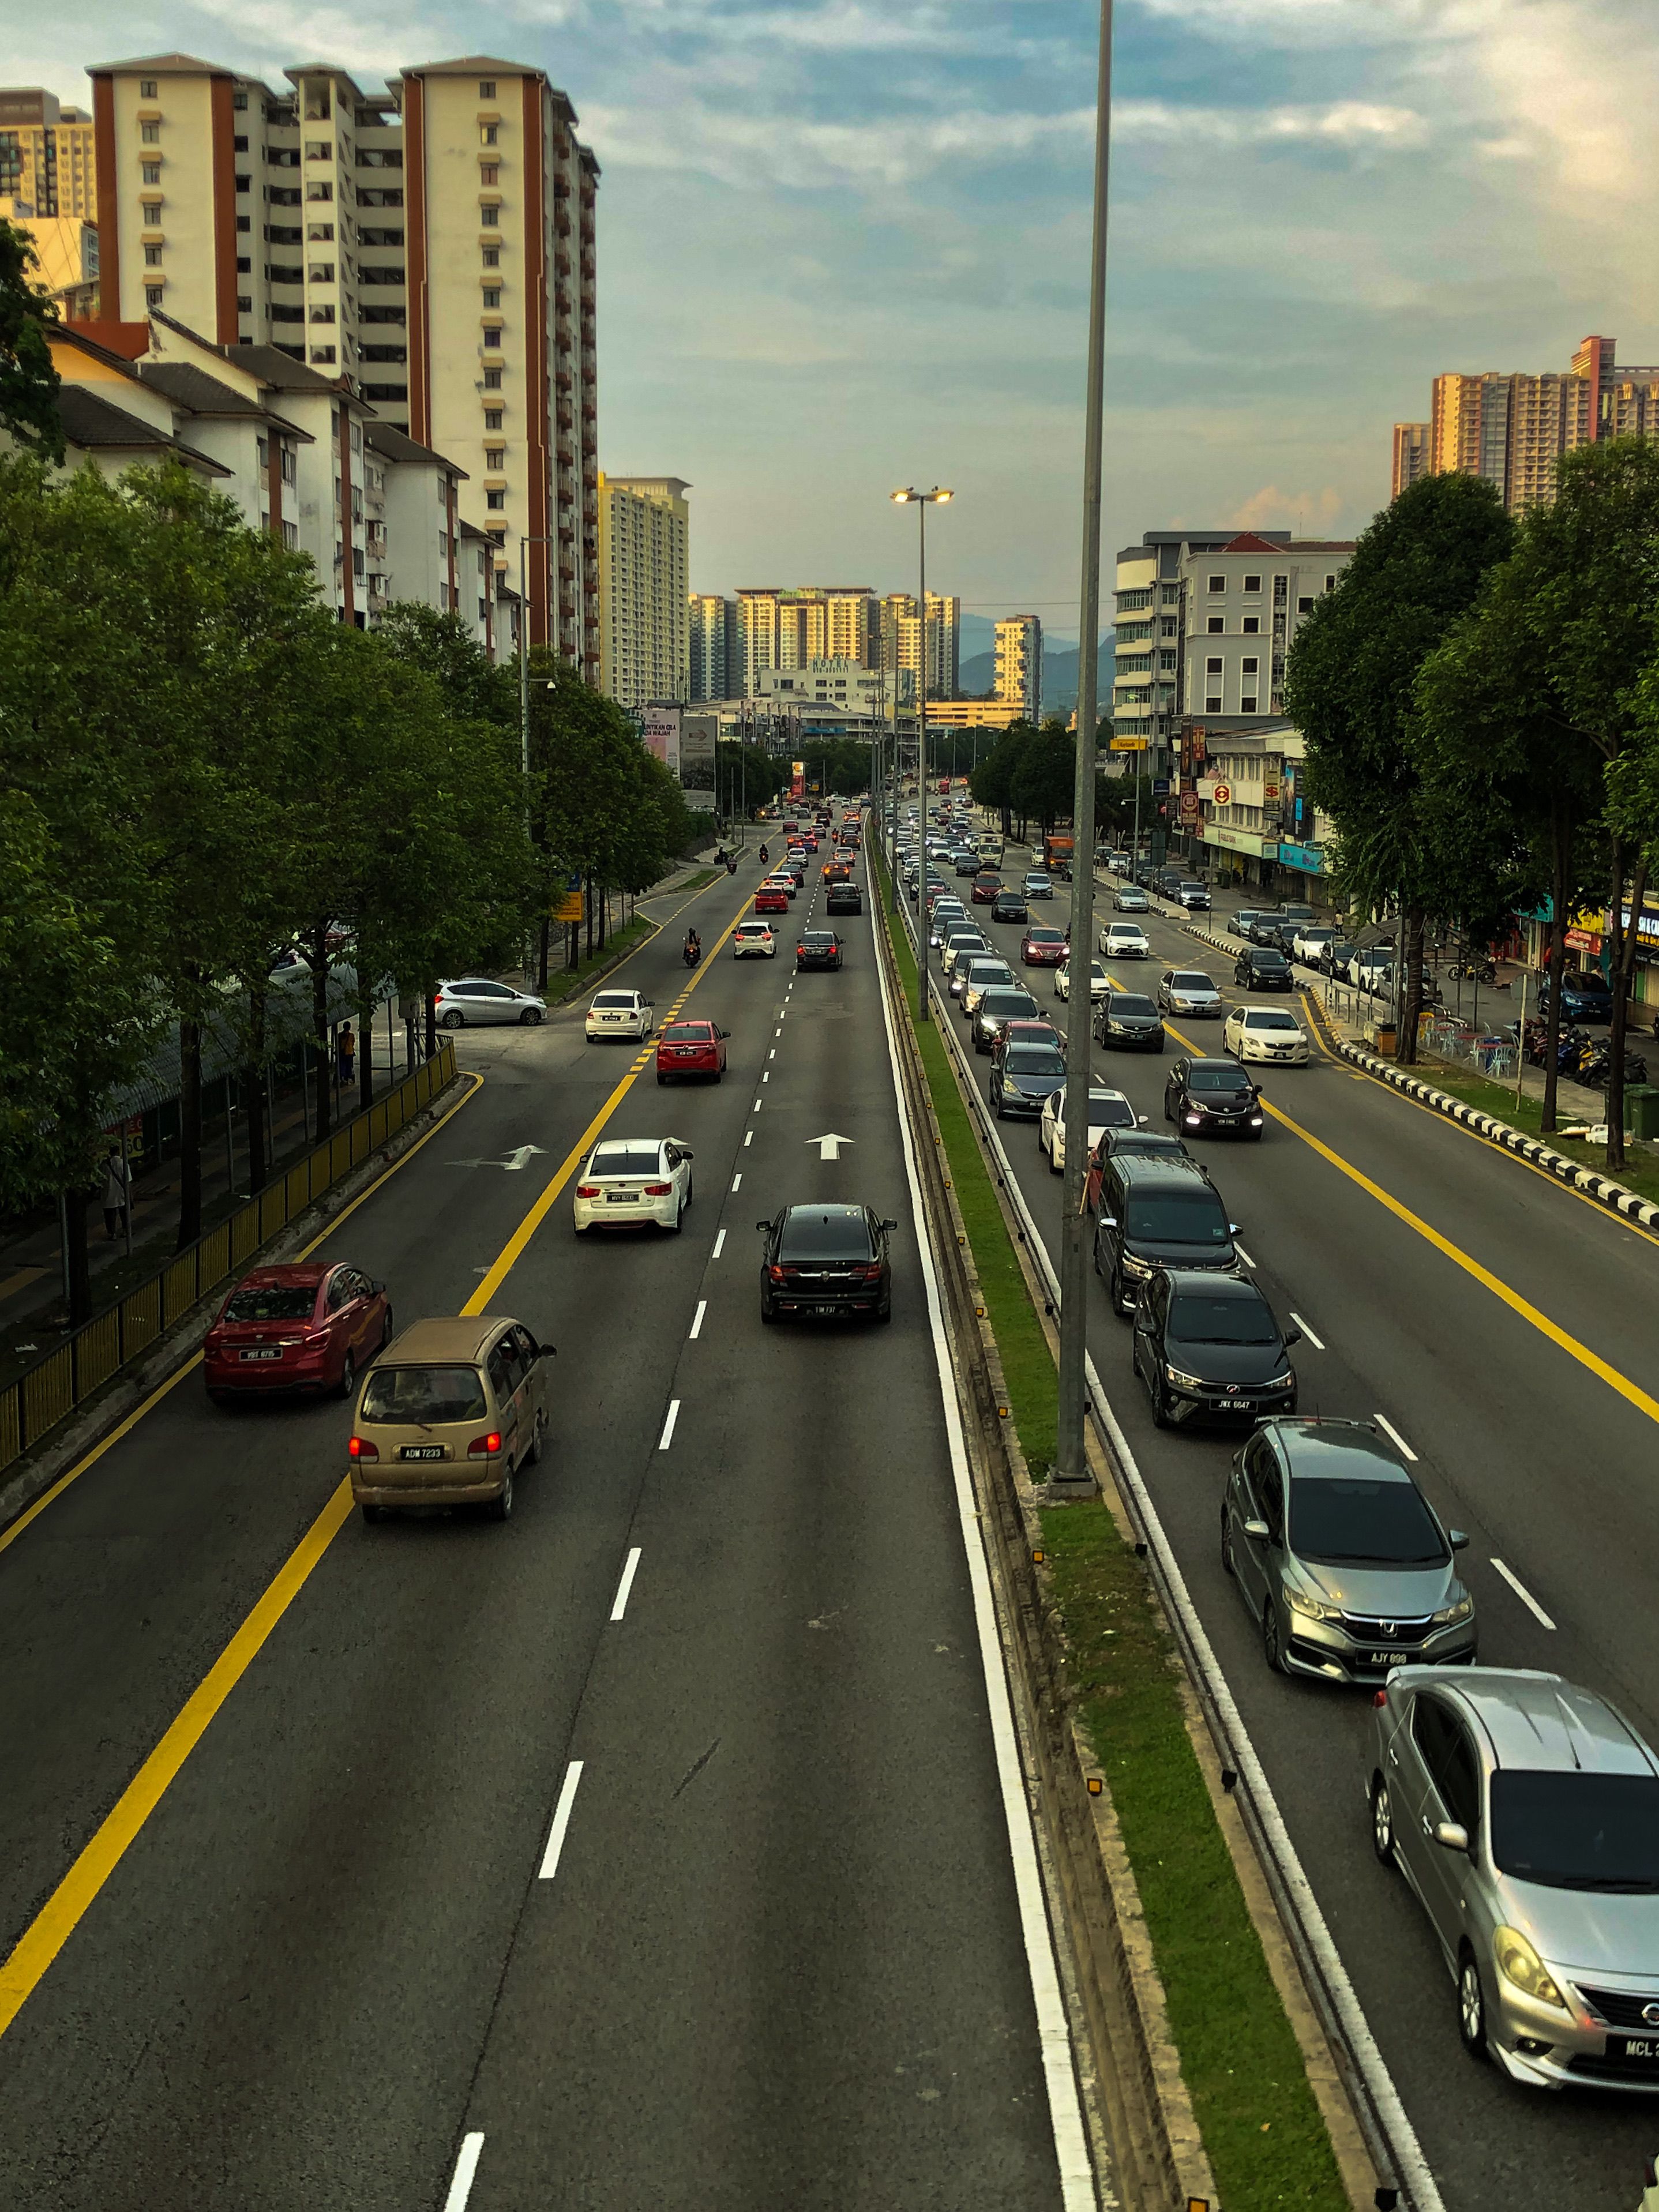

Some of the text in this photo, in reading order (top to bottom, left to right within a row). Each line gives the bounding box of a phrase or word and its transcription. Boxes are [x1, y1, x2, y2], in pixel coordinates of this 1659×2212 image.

[813, 659, 848, 667] HOTEL
[1371, 1652, 1388, 1663] AJY
[1626, 2041, 1653, 2057] MCL
